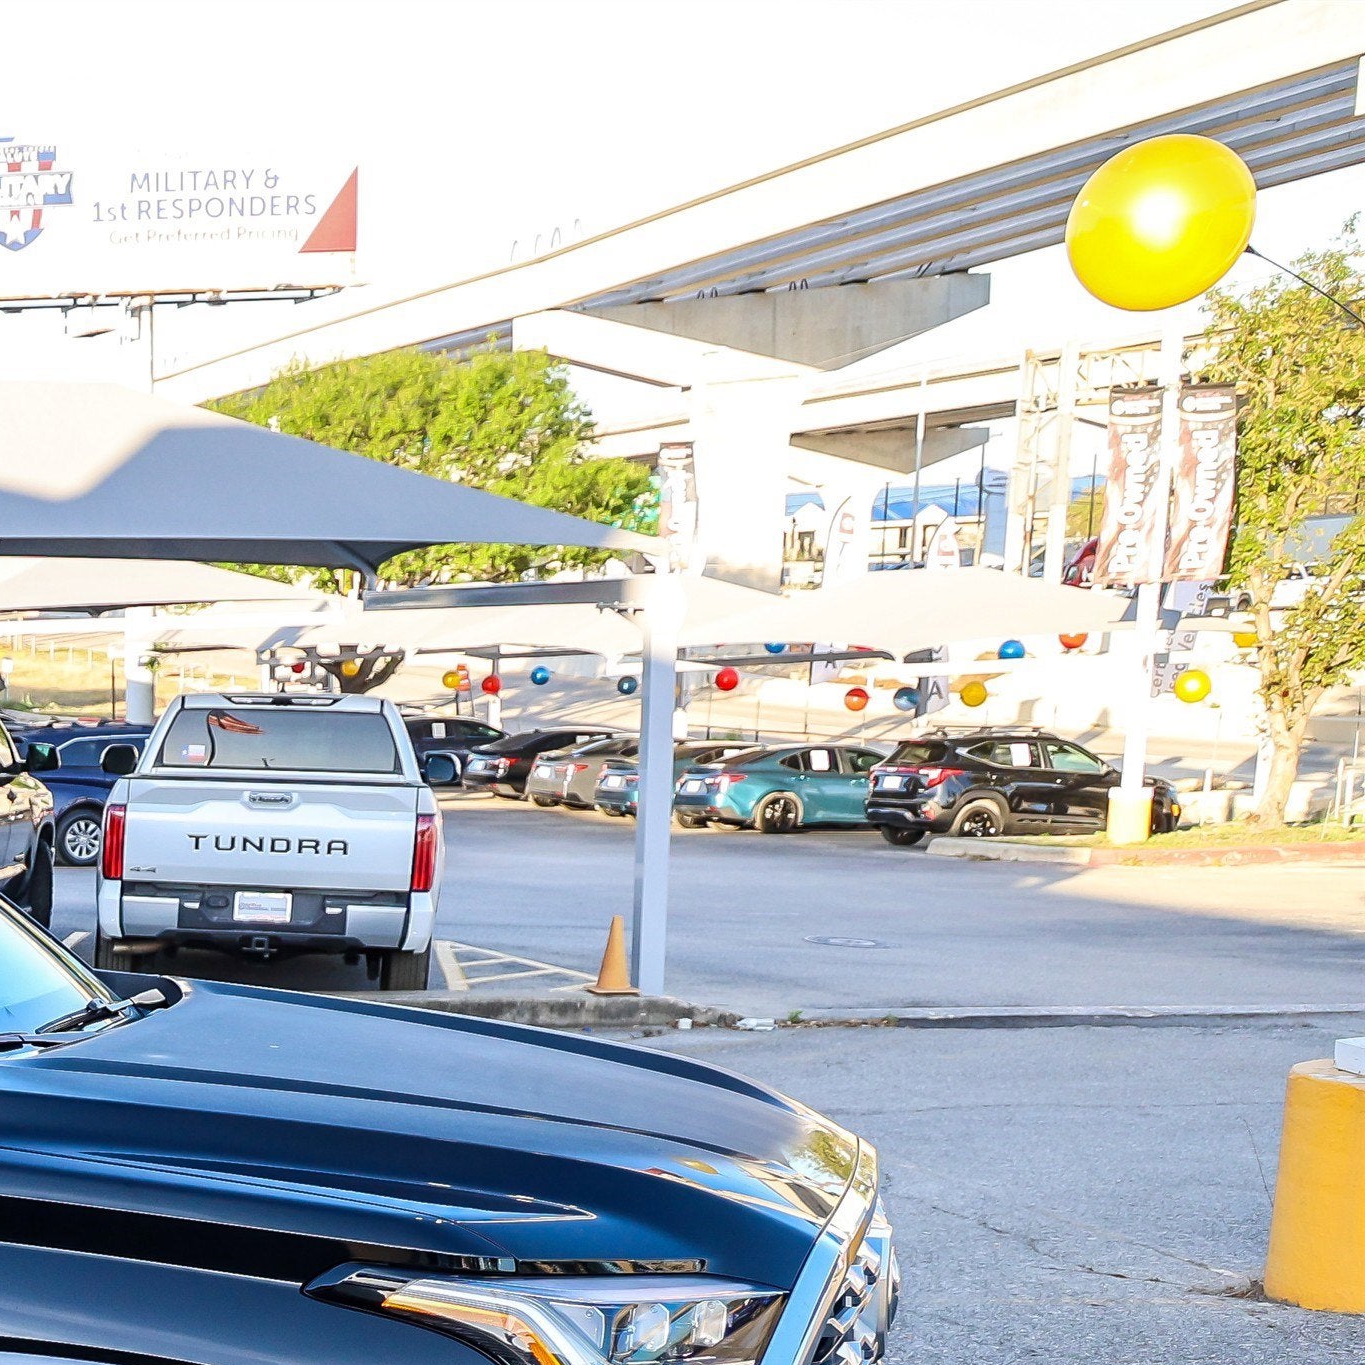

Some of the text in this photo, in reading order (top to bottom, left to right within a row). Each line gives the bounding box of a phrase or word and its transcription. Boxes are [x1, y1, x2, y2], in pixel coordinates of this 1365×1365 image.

[130, 168, 280, 193] MILITARY &
[92, 194, 317, 222] 1st RESPONDERS
[185, 832, 351, 857] TUNDRA
